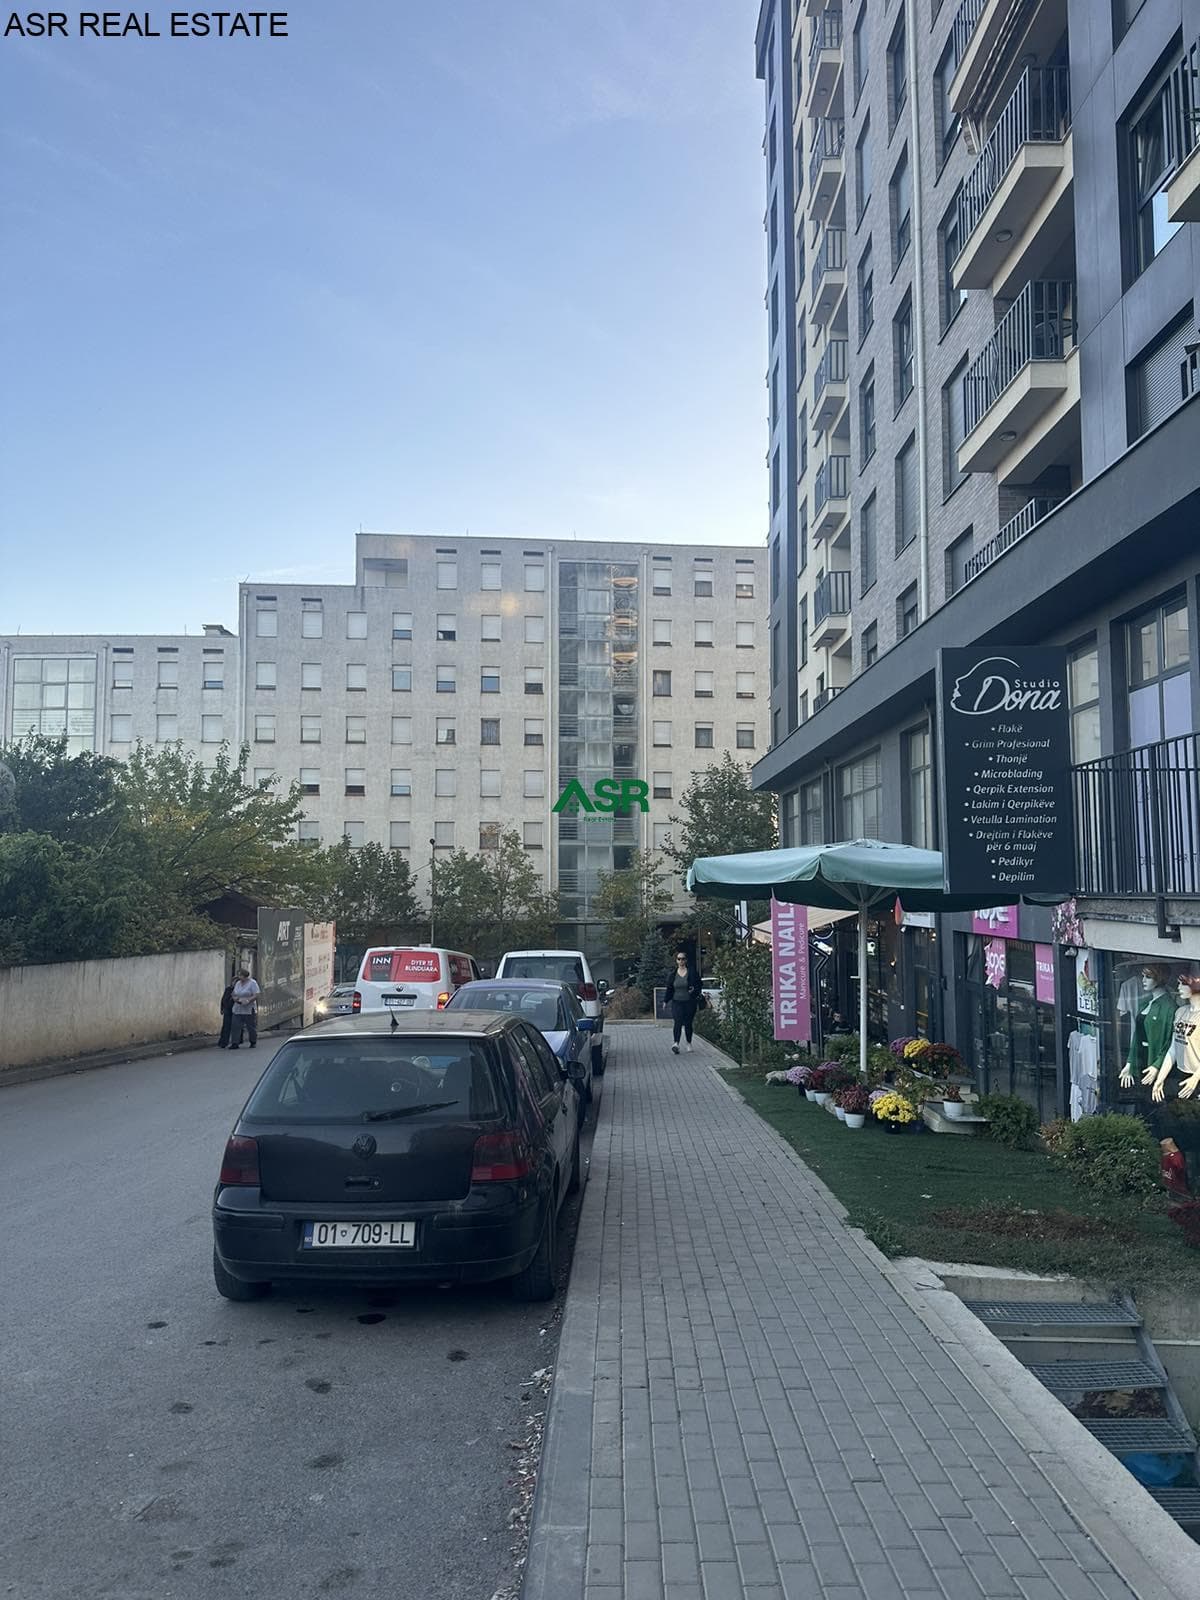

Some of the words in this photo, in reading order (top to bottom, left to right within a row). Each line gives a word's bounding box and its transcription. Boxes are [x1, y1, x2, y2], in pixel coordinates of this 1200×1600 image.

[1014, 678, 1060, 689] Studio
[972, 675, 1062, 714] Dona
[971, 740, 995, 749] Grim
[997, 739, 1051, 750] Profesional
[996, 754, 1028, 765] Thonjë
[981, 769, 1043, 780] Microblading
[973, 784, 1005, 795] Qerpik
[1007, 783, 1054, 794] Extension
[971, 799, 1000, 809] Lakim
[1007, 799, 1056, 810] Qerpikëve
[971, 815, 1003, 824] Vetulla
[1005, 814, 1057, 823] Lamination
[976, 830, 1010, 840] Drejtim
[1017, 830, 1054, 839] Flokëve
[986, 842, 1002, 852] për
[1004, 842, 1011, 851] 6
[1013, 842, 1037, 852] muaj
[998, 856, 1034, 867] Pedikyr
[998, 872, 1035, 883] Depilim
[372, 957, 392, 965] INN
[779, 961, 798, 1029] TRIKA
[318, 1224, 338, 1244] 01
